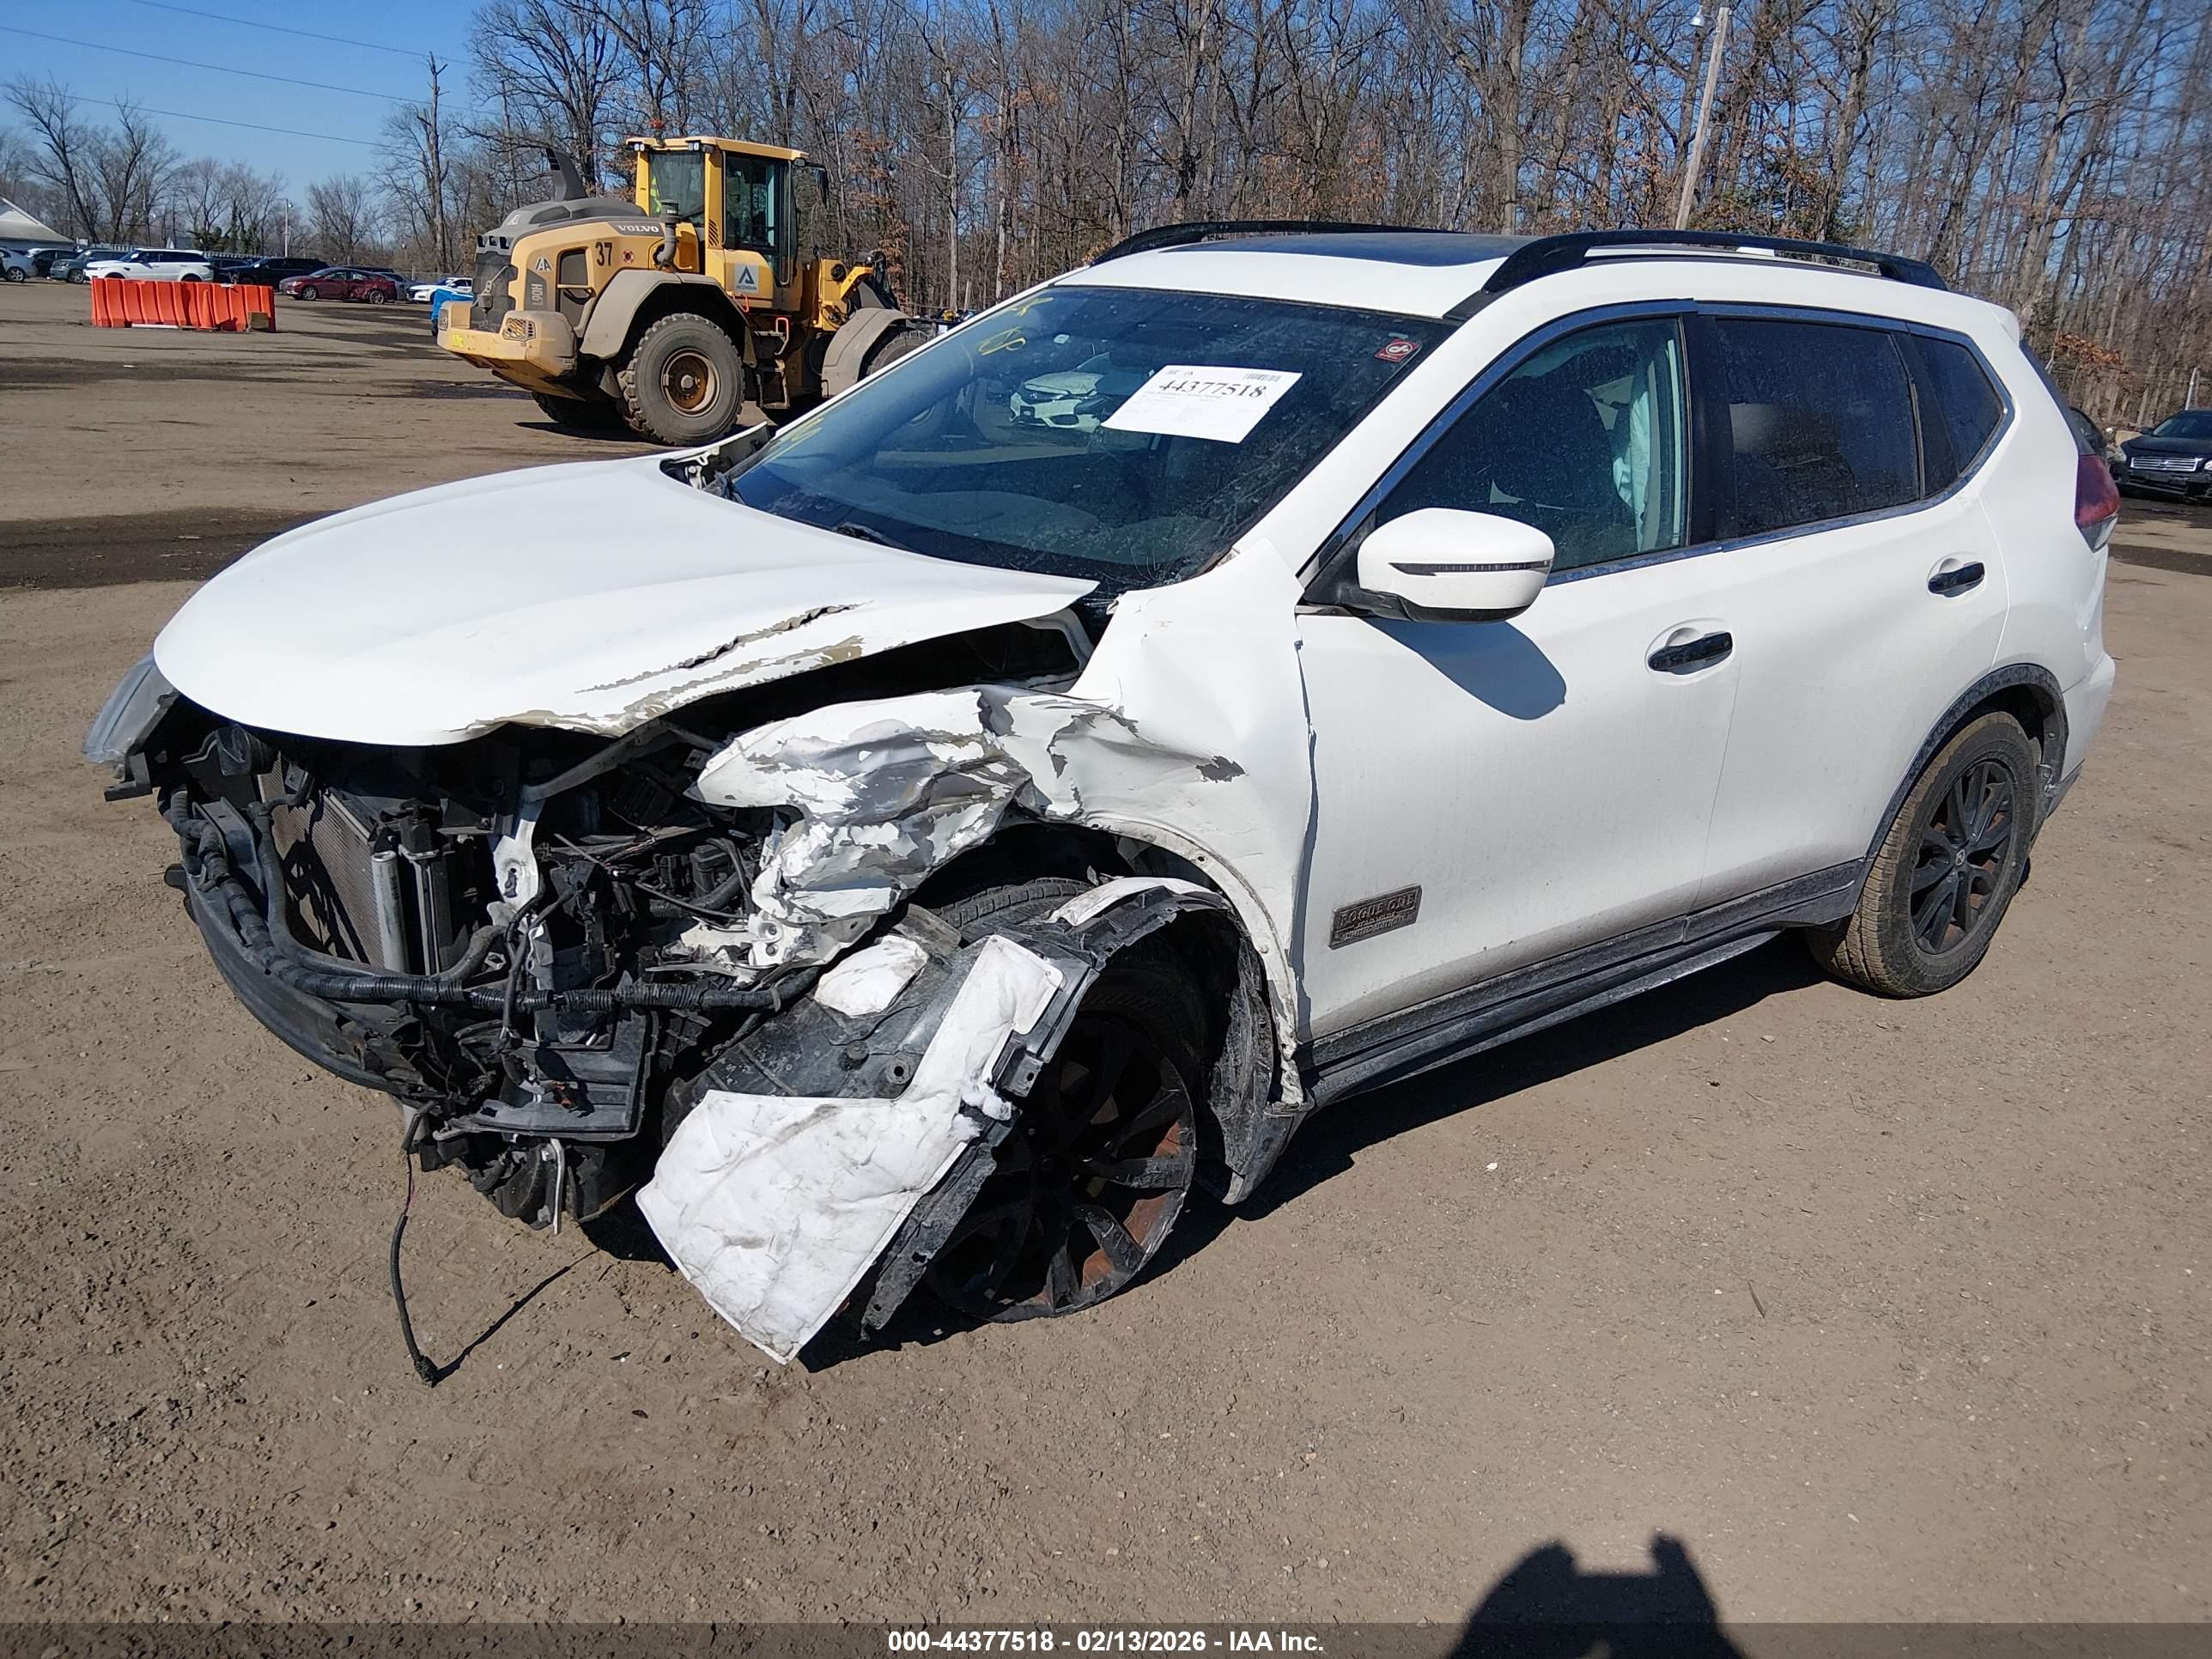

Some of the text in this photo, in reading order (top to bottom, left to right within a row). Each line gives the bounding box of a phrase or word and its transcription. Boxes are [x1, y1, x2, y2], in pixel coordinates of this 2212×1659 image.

[617, 224, 659, 234] VOLVO
[594, 241, 613, 267] 37
[531, 283, 544, 306] L90H
[1159, 380, 1267, 398] 44377518
[1340, 894, 1415, 926] ROGUE ONE
